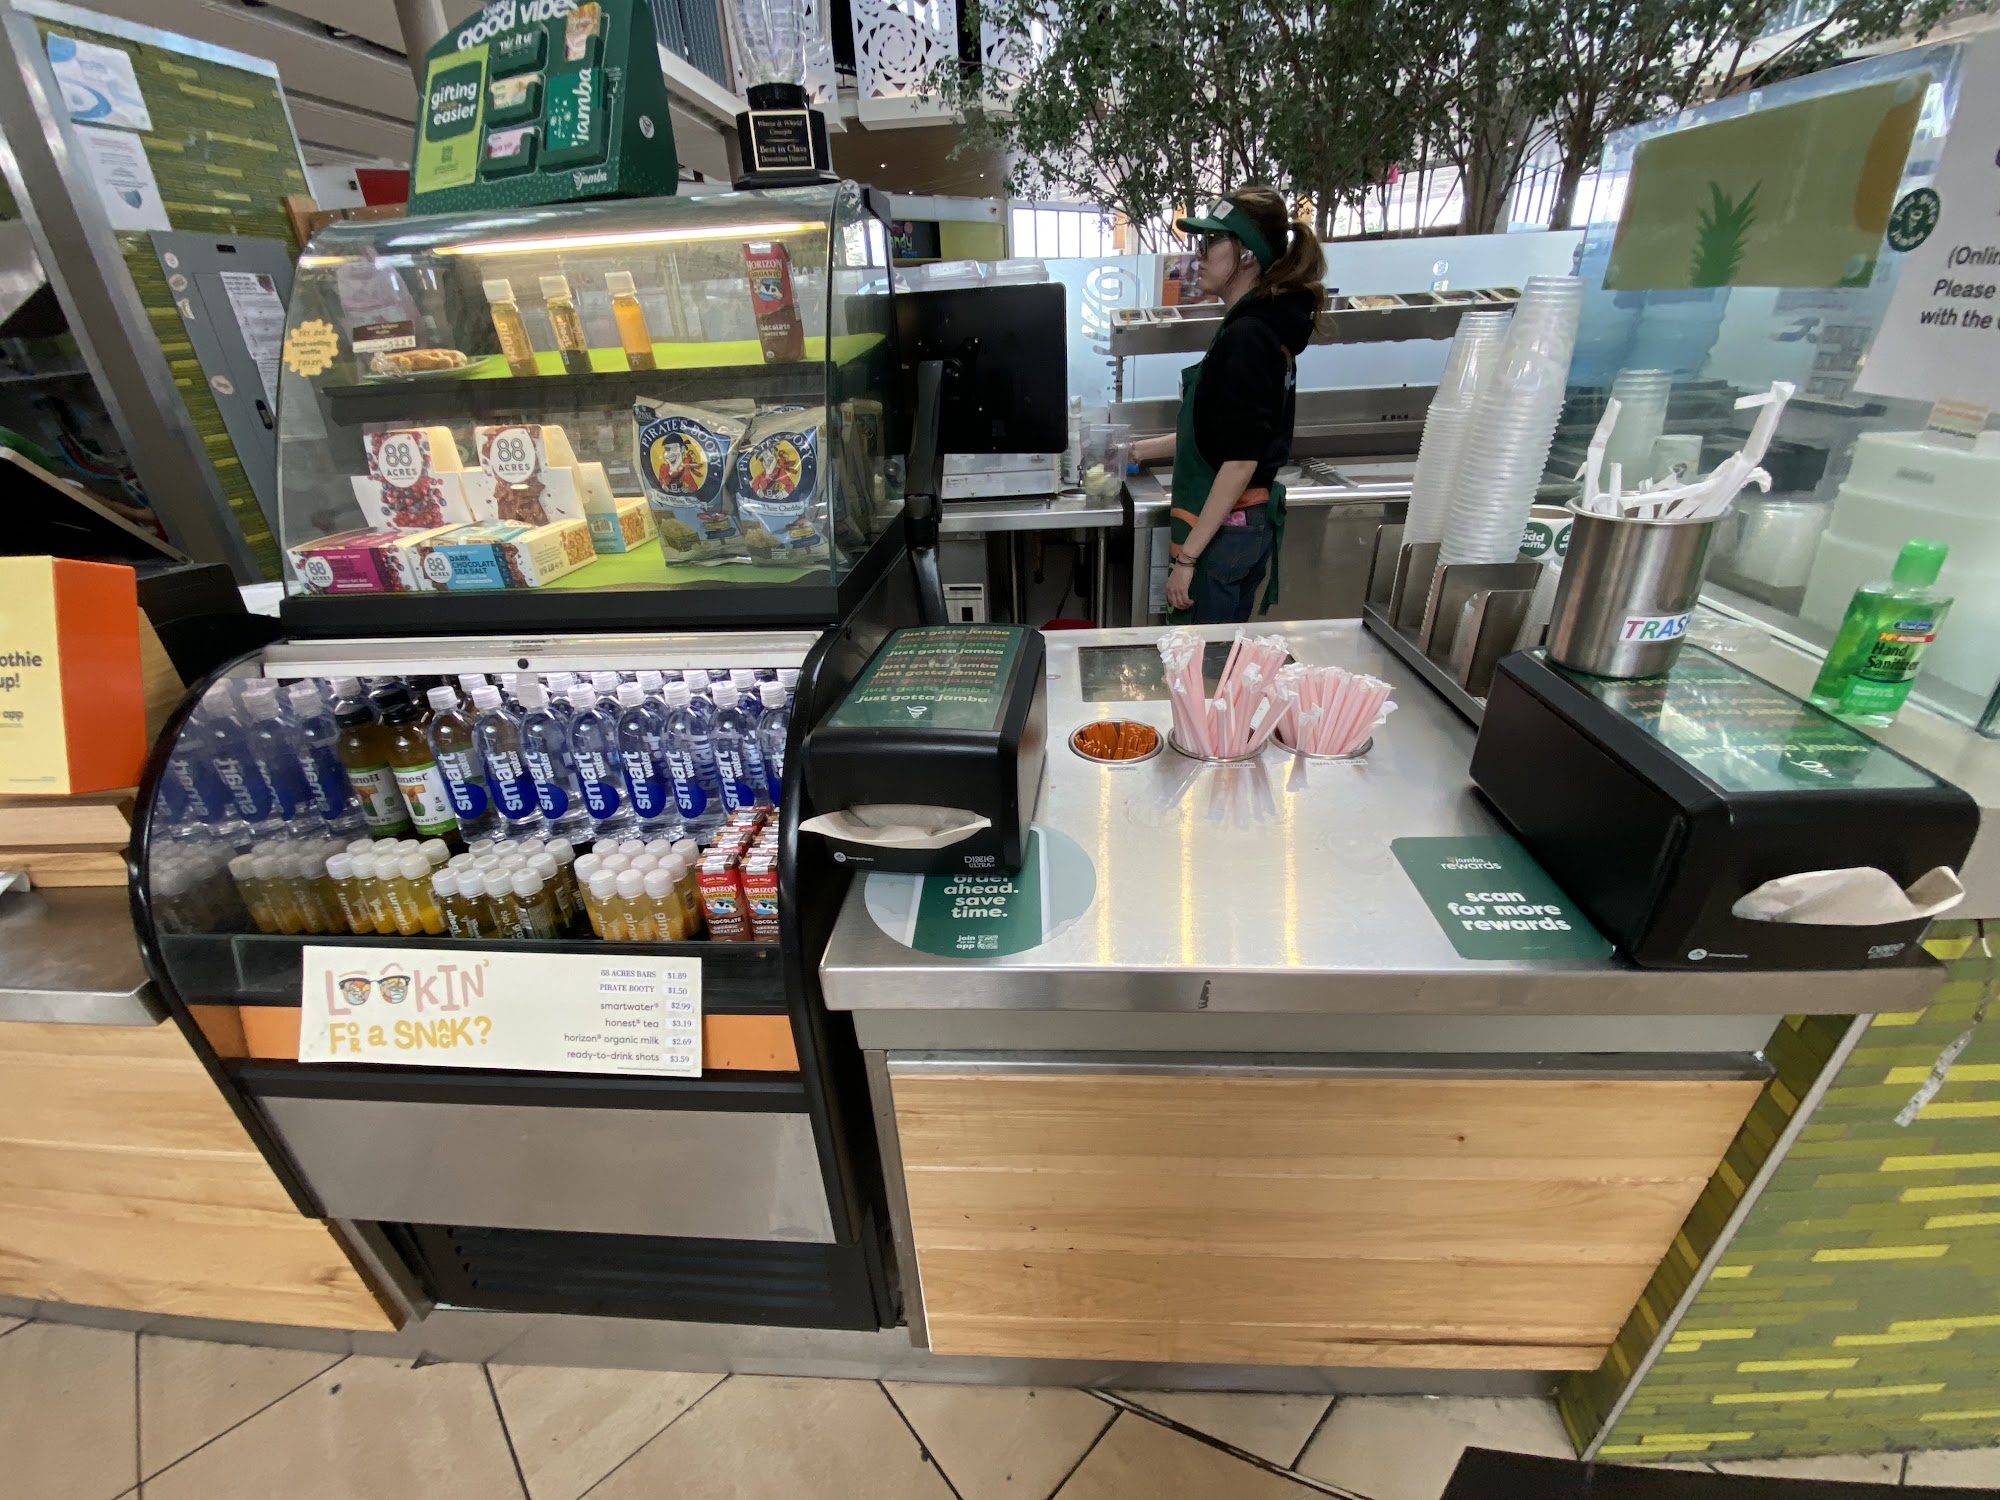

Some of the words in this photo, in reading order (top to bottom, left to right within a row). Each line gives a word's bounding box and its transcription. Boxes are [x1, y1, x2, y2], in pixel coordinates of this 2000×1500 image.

[431, 82, 477, 110] gifting
[433, 104, 476, 126] easier
[746, 260, 783, 270] HORIZON
[1933, 278, 1996, 299] Please
[1920, 308, 1958, 326] with
[1962, 309, 1993, 329] the
[641, 418, 688, 449] PIRATE'S
[385, 443, 413, 467] 88
[497, 437, 526, 462] 88
[387, 468, 418, 476] ACRES
[499, 463, 531, 472] ACRES
[308, 561, 327, 575] 88
[427, 558, 445, 572] 88
[452, 561, 496, 569] CHOCOLATE
[967, 627, 1010, 636] jamba
[886, 649, 915, 657] just
[1871, 642, 1910, 656] Hand
[878, 663, 907, 671] just
[1864, 655, 1920, 671] Sanitizer
[872, 670, 902, 679] just
[855, 694, 888, 703] just
[890, 694, 935, 702] gotta
[935, 693, 988, 703] jamba
[456, 751, 473, 779] water
[507, 750, 524, 778] water
[539, 752, 555, 779] water
[592, 751, 607, 779] water
[640, 750, 655, 779] water
[682, 750, 695, 779] water
[730, 750, 744, 778] water
[396, 772, 428, 784] onest
[438, 752, 473, 811] smart
[487, 752, 524, 811] smart
[525, 752, 554, 811] smart
[574, 751, 605, 811] smart
[622, 750, 652, 811] smart
[665, 750, 692, 810] smart
[714, 749, 741, 809] smart
[1440, 861, 1502, 871] rewards
[1454, 856, 1485, 866] jamba
[700, 884, 737, 895] HORIZON
[943, 882, 1019, 895] ahead.
[954, 896, 1007, 906] save
[1465, 891, 1526, 903] scan
[951, 906, 1008, 919] time.
[1447, 902, 1487, 917] for
[1493, 903, 1562, 916] more
[708, 917, 742, 925] CHOCOLATE
[1461, 917, 1573, 932] rewards
[957, 934, 976, 942] join
[611, 970, 636, 978] ACRES
[636, 970, 657, 978] BARS
[667, 972, 687, 980] $1.89
[599, 984, 627, 992] PIRATE
[628, 984, 655, 993] BOOTY
[667, 986, 688, 995] $1.50
[671, 1001, 691, 1010] $2.99
[643, 1020, 659, 1028] tea
[672, 1019, 692, 1028] $3.19
[329, 1022, 362, 1055] FOR
[367, 1024, 388, 1046] a
[393, 1015, 492, 1050] SNACK?
[603, 1035, 638, 1046] organic
[640, 1036, 659, 1046] milk
[672, 1037, 692, 1046] $2.69
[566, 1050, 633, 1061] ready-to-drink
[635, 1052, 660, 1062] shots
[669, 1055, 690, 1063] $3.59
